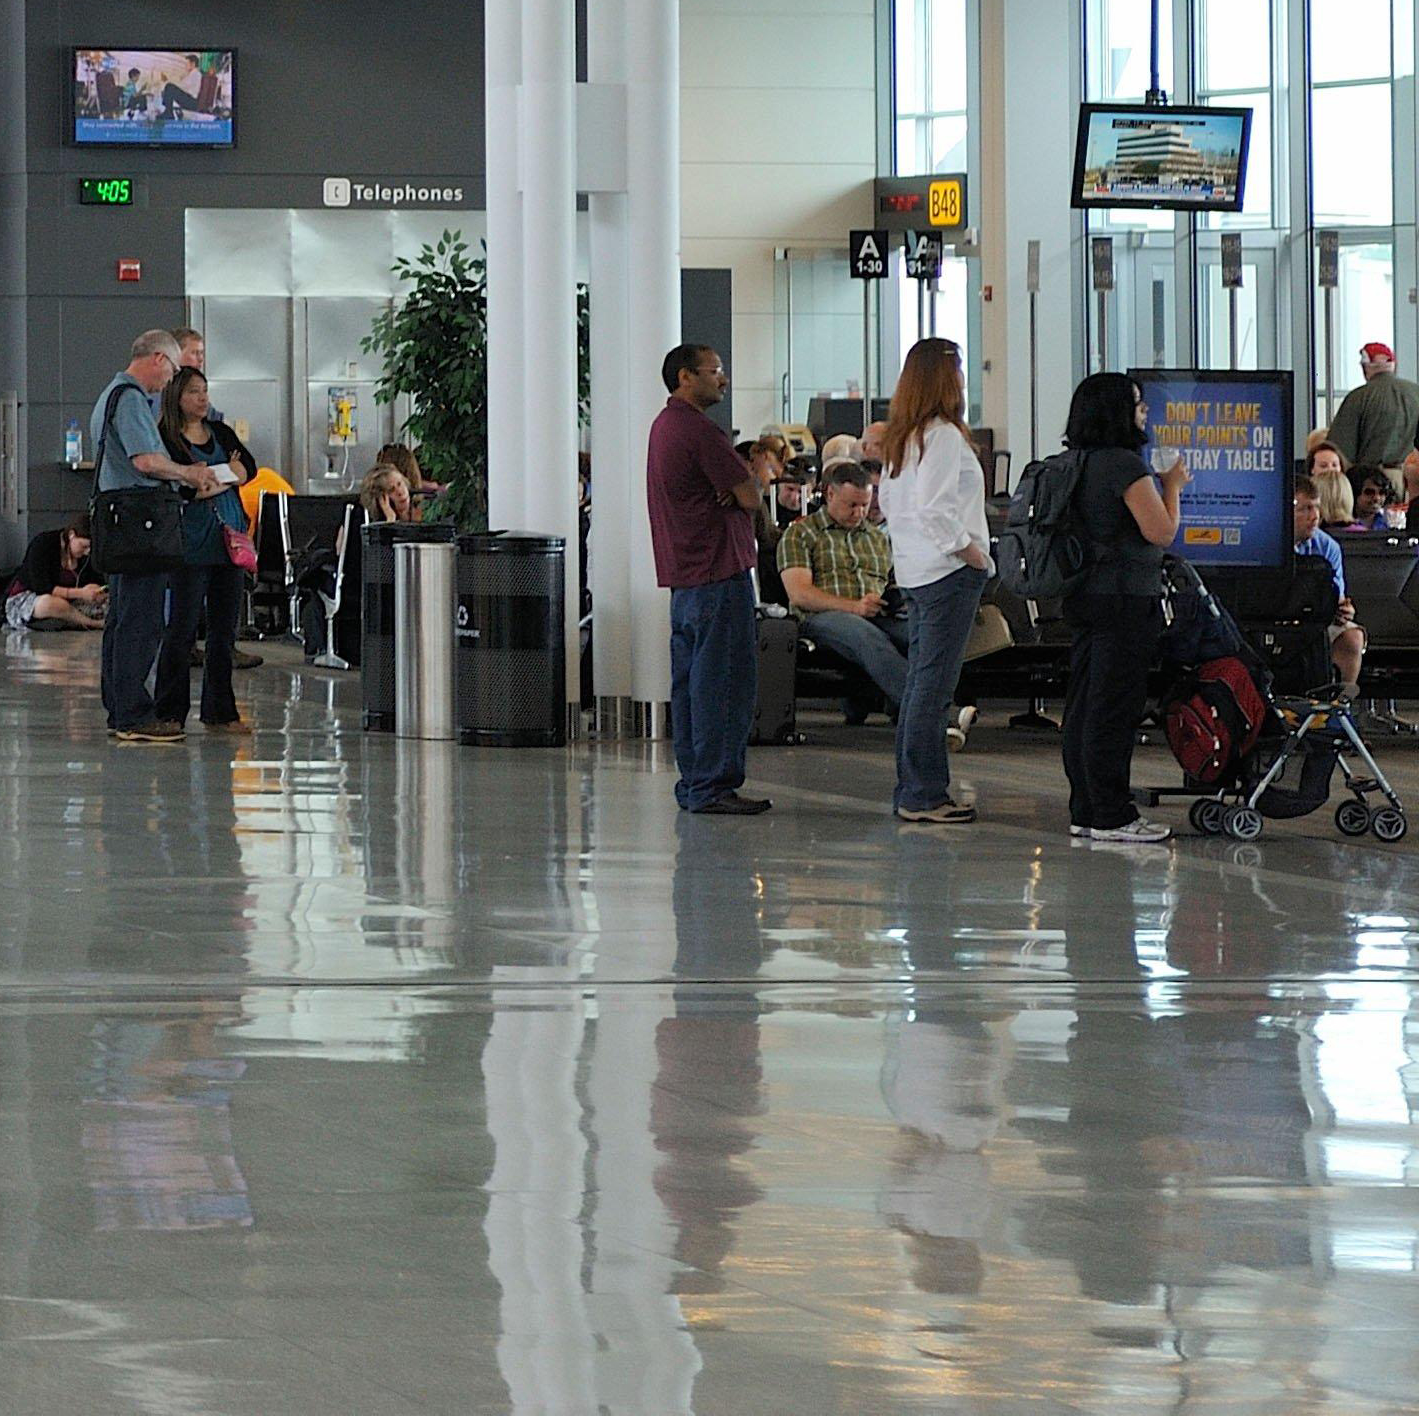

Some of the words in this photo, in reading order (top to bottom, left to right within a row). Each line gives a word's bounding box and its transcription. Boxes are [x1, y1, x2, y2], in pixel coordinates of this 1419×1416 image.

[97, 180, 130, 203] 4:05
[352, 183, 464, 205] Telephones
[931, 188, 958, 218] B48
[858, 234, 880, 259] A
[856, 259, 883, 274] 1-30
[1165, 402, 1211, 425] DON'T
[1216, 402, 1261, 425] LEAVE
[1153, 424, 1192, 447] YOUR
[1196, 425, 1248, 448] POINTS
[1252, 426, 1274, 448] ON
[1184, 448, 1221, 471] TRAY
[1224, 449, 1275, 472] TABLE!
